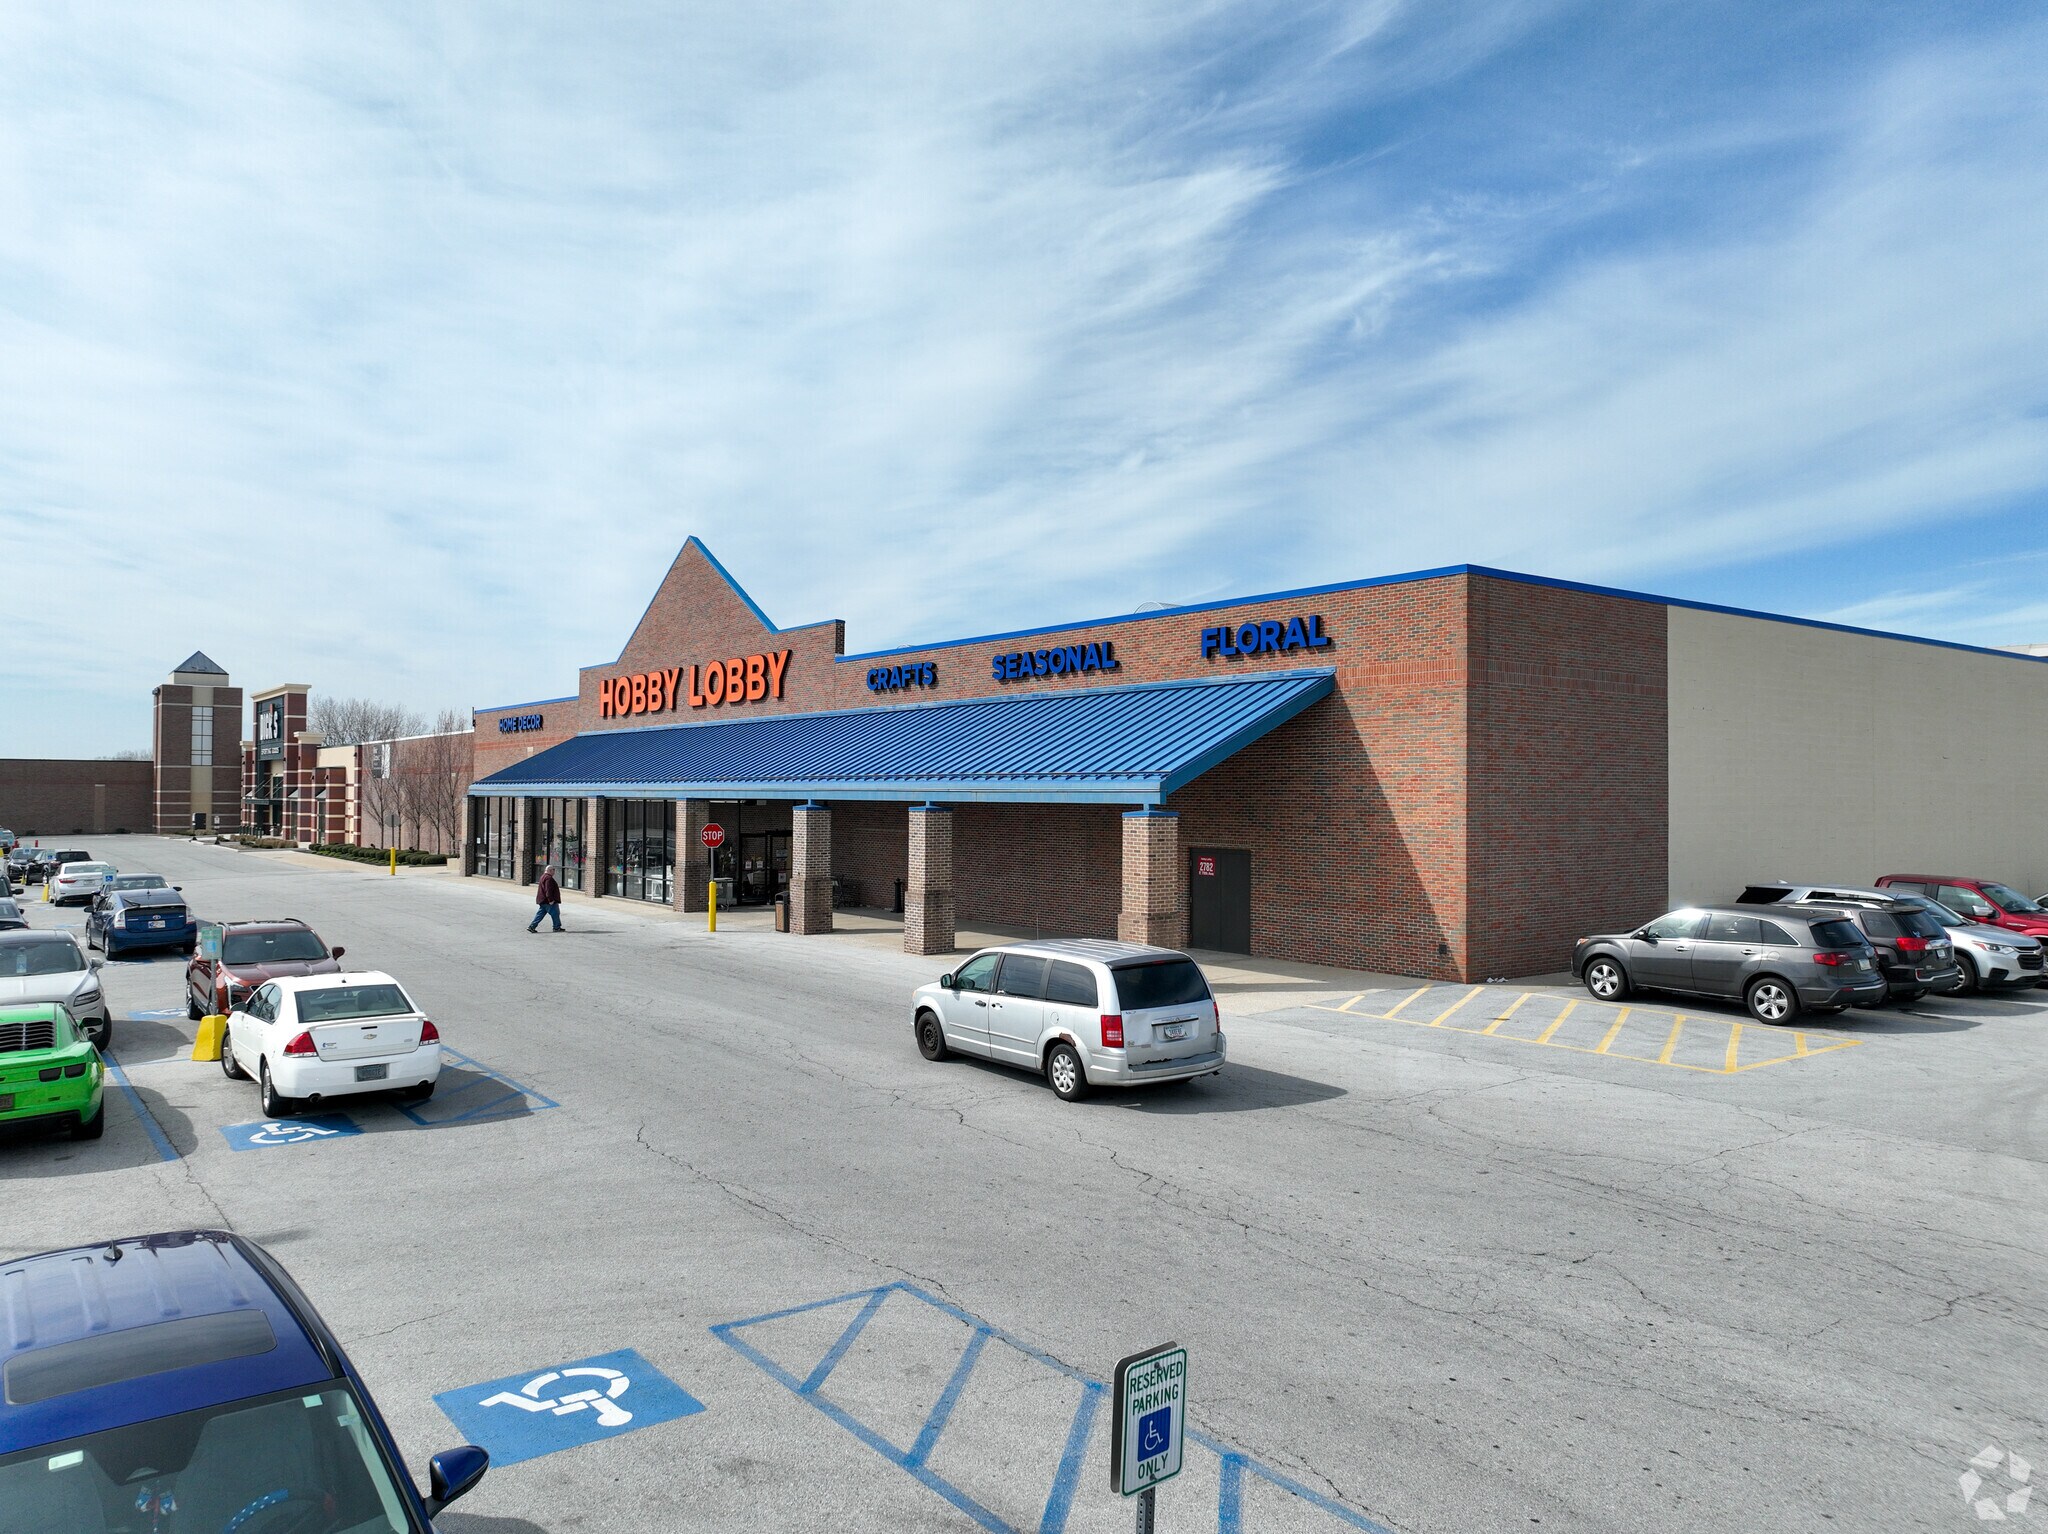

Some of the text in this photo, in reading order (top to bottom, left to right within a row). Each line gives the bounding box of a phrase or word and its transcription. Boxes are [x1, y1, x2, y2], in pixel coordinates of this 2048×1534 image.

[1200, 615, 1331, 658] FLORAL
[866, 661, 937, 691] CRAFTS
[991, 641, 1119, 680] SEASONAL
[599, 649, 793, 718] HOBBY LOBBY
[499, 714, 542, 732] HOME DECOR
[702, 830, 723, 841] STOP
[1129, 1360, 1183, 1395] RESERVED
[1132, 1383, 1179, 1416] PARKING
[1137, 1452, 1169, 1480] ONLY
